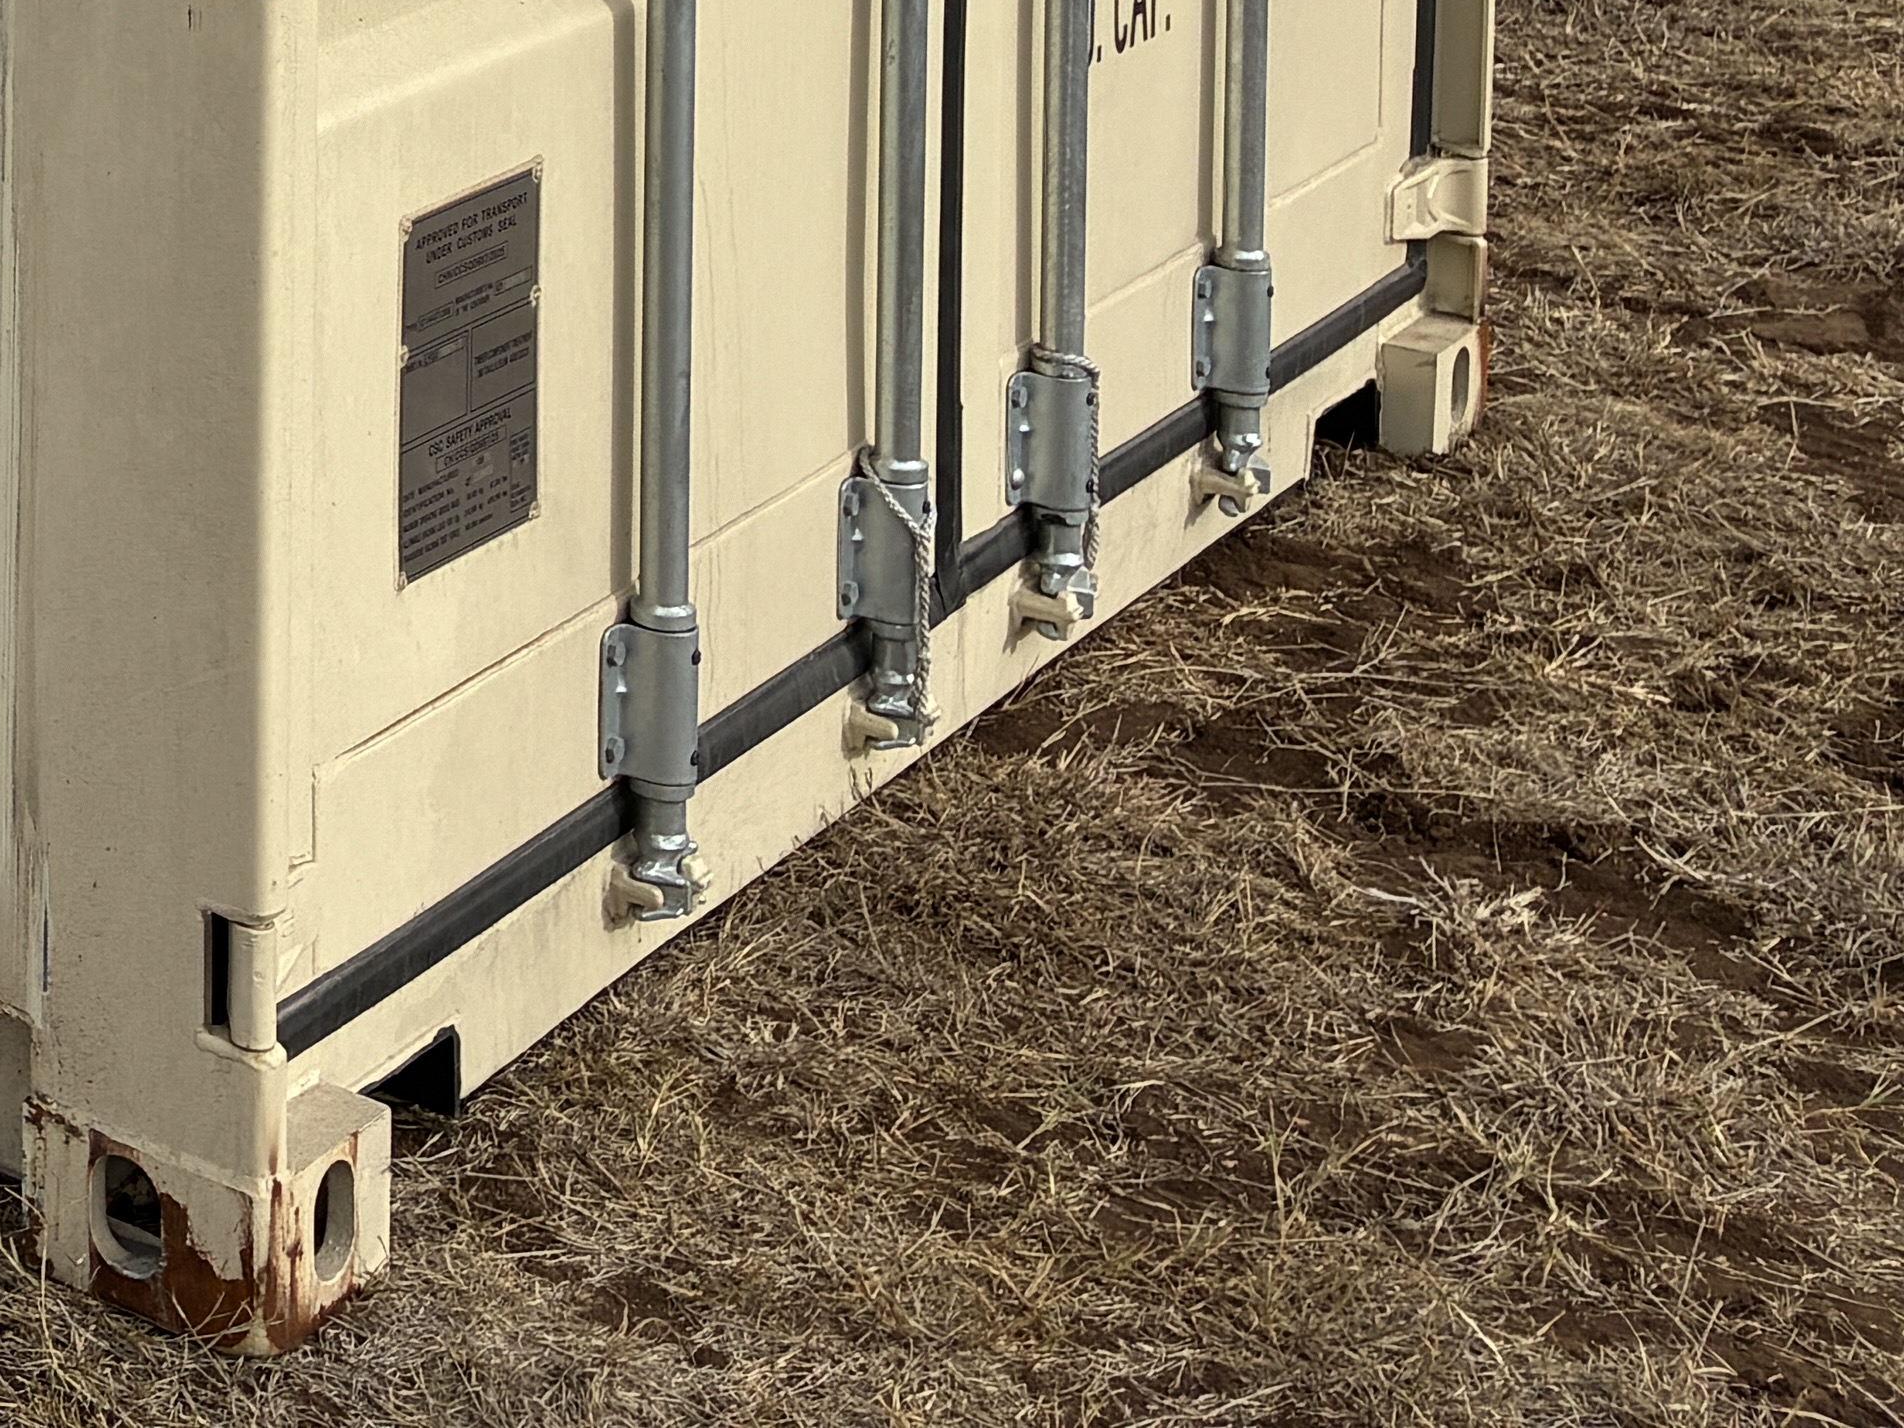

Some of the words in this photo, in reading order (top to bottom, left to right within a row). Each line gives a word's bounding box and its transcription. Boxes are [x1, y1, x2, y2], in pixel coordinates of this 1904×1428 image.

[415, 222, 460, 251] APPROVED
[461, 213, 479, 231] FOR
[481, 192, 528, 222] TRANSPORT
[426, 242, 452, 265] UNDER
[457, 223, 493, 250] CUSTOMS
[497, 214, 518, 233] SEAL
[428, 439, 444, 457] CSC
[446, 426, 472, 449] SAFETY
[475, 407, 512, 433] APPROVAL
